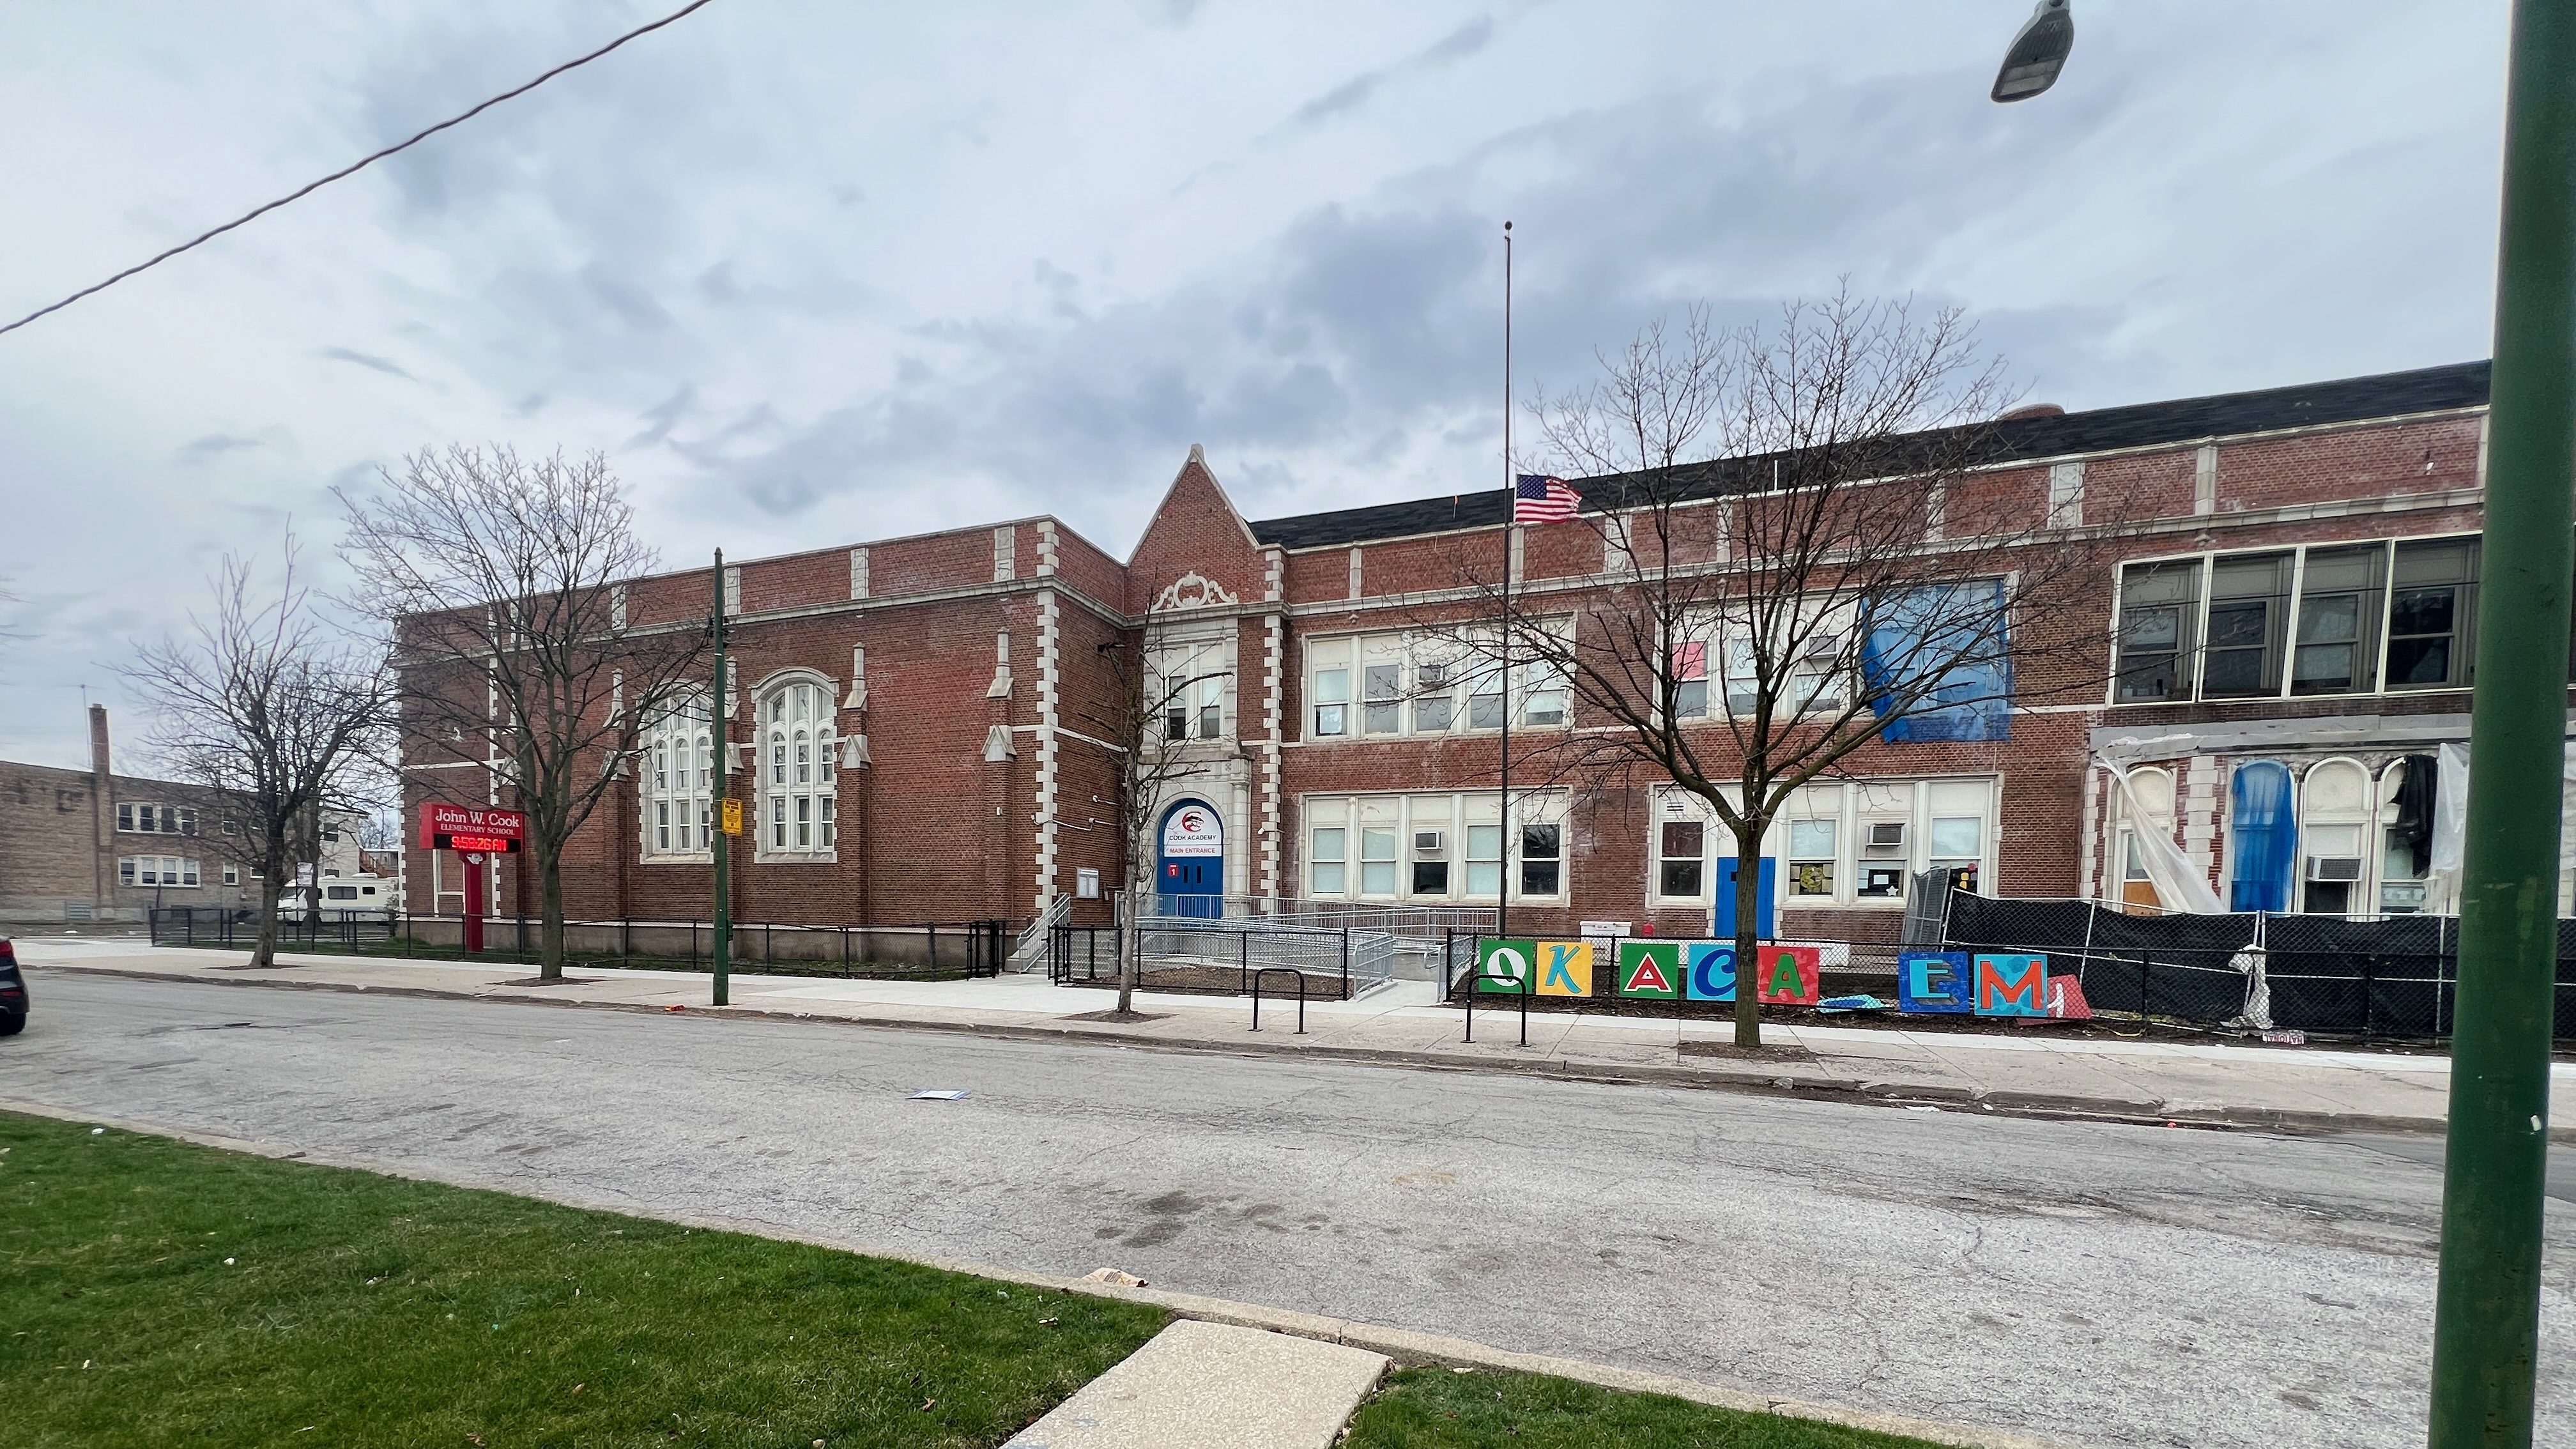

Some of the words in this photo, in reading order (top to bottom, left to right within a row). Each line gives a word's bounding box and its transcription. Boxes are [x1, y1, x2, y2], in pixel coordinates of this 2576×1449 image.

[435, 808, 466, 823] John
[470, 811, 485, 825] W.
[488, 813, 519, 827] Cook
[440, 824, 486, 833] ELEMENTARY
[452, 836, 491, 849] 9:58:26
[492, 839, 507, 851] AM
